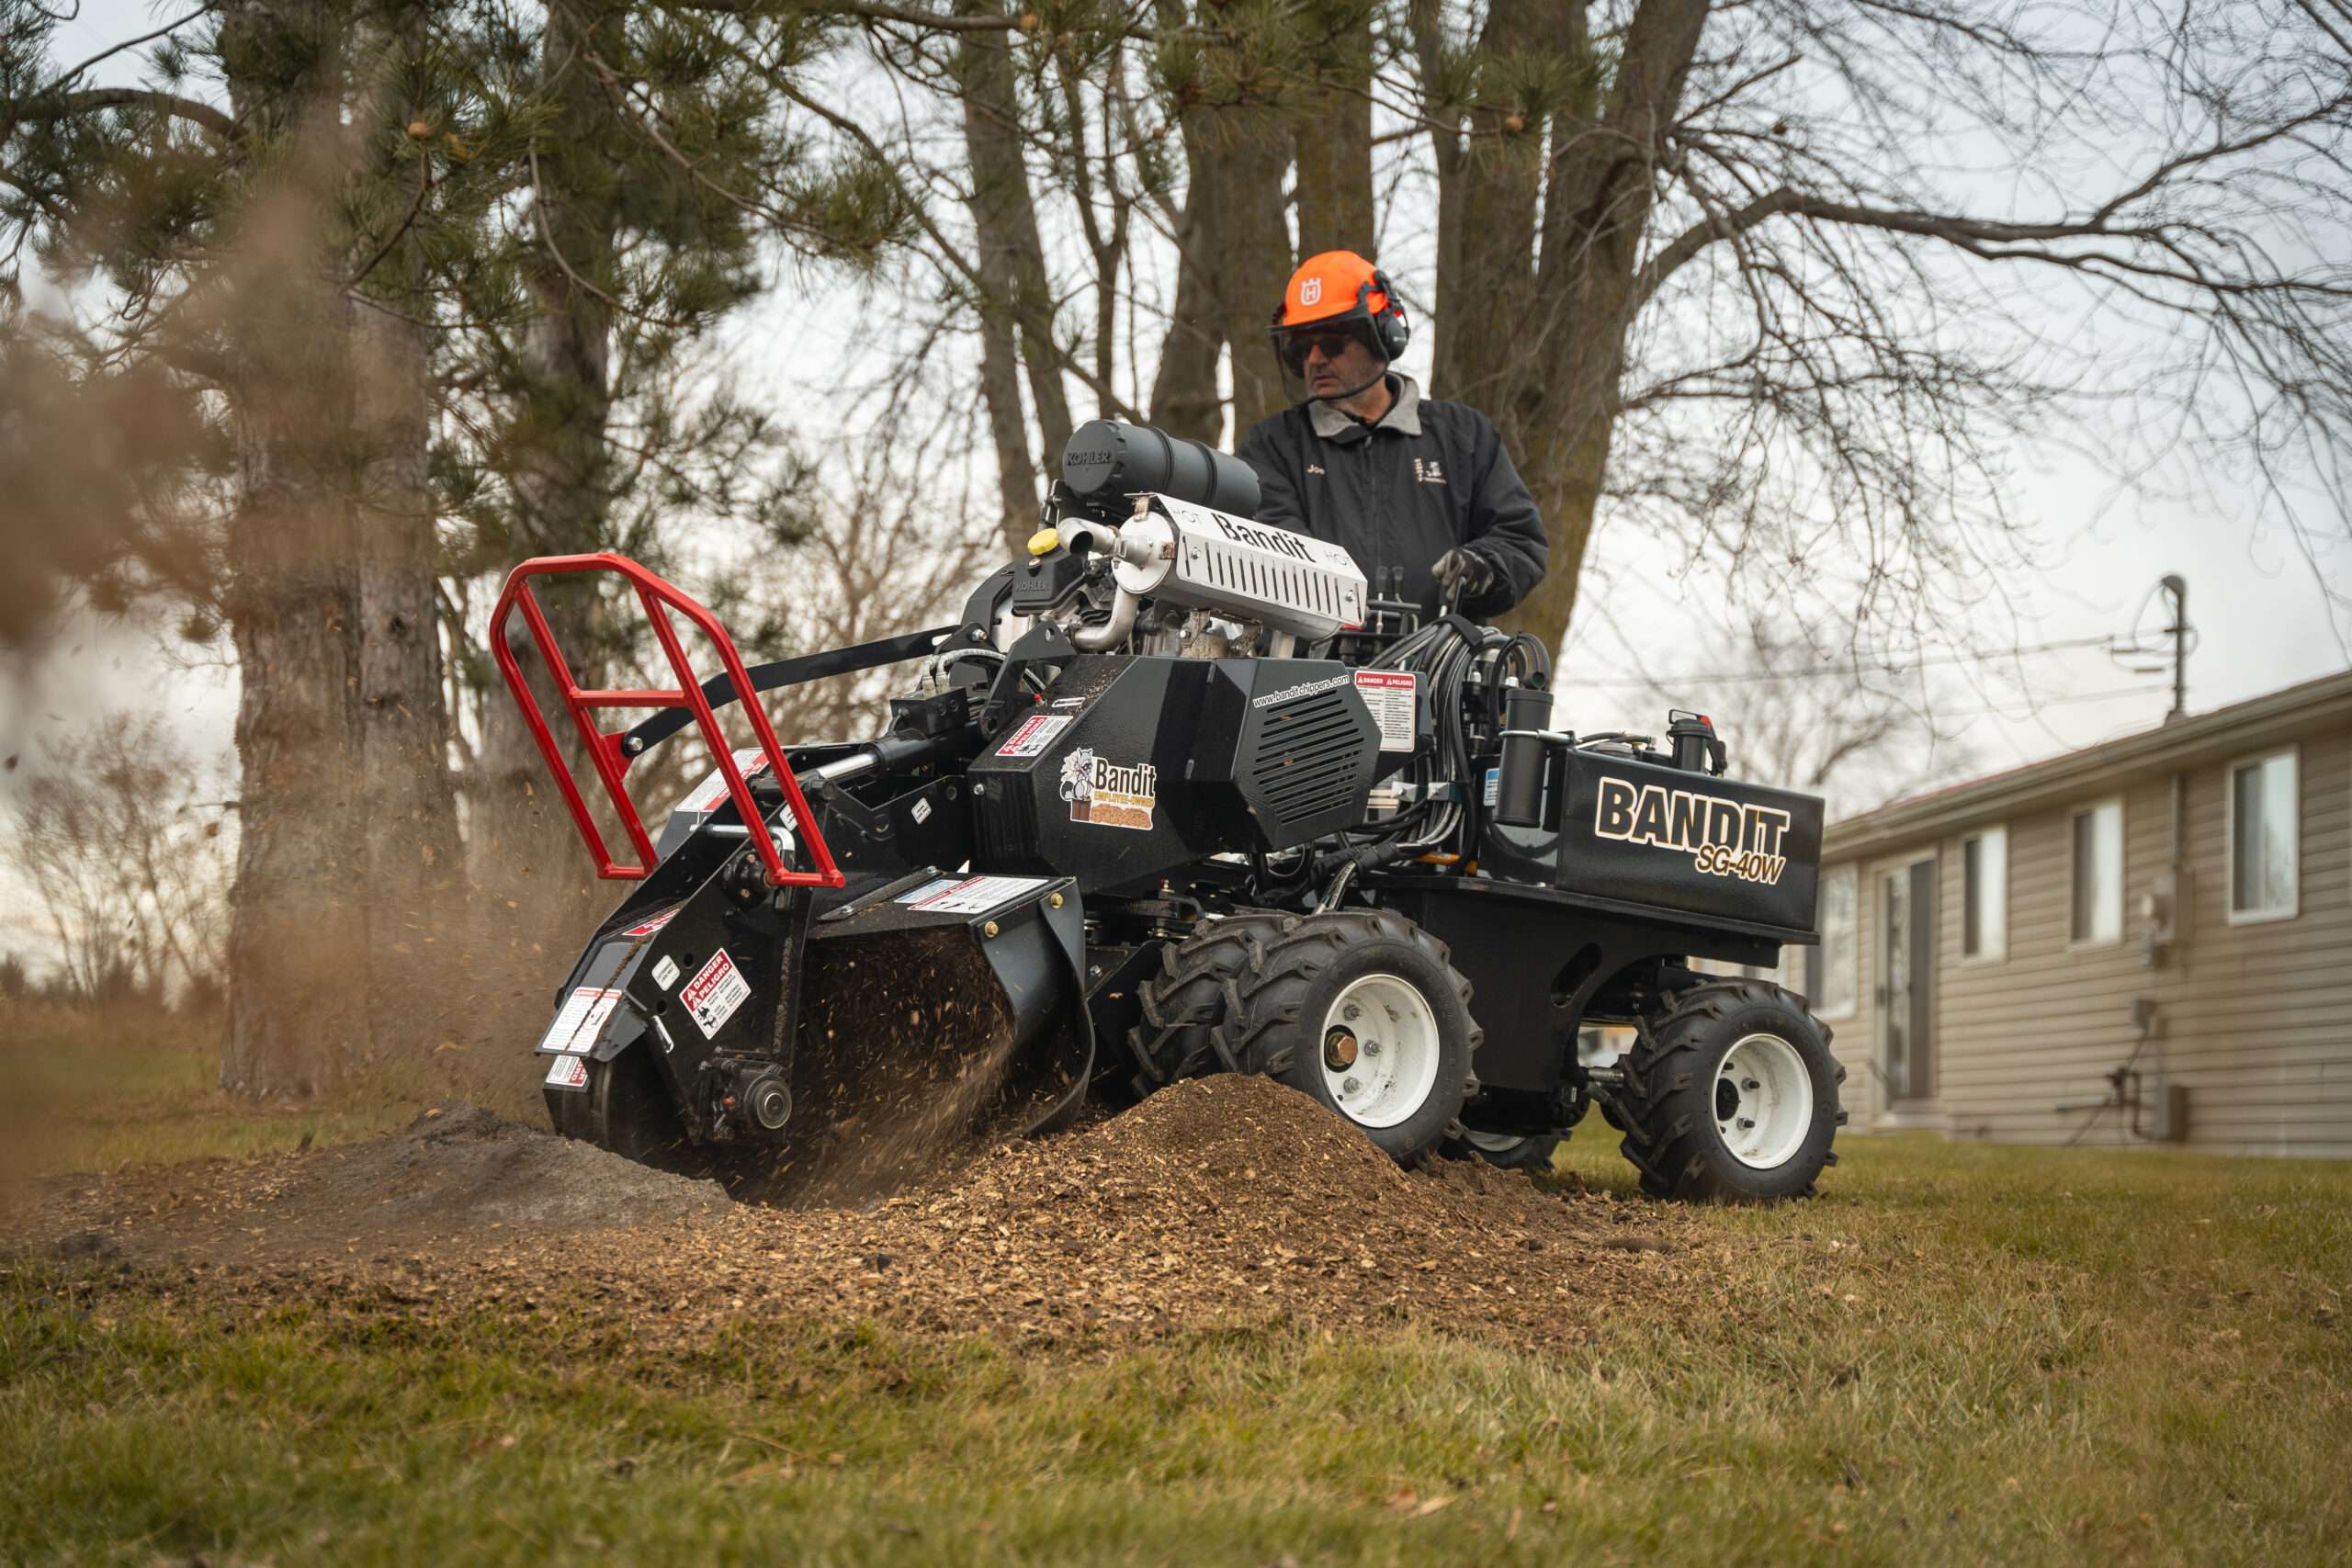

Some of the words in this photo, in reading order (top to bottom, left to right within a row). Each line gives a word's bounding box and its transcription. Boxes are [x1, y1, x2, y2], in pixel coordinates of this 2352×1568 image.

[1067, 451, 1111, 467] KOHLER
[1211, 512, 1317, 563] Bandit
[1252, 674, 1351, 707] www.banditchippers.com
[1094, 758, 1156, 797] Bandit
[1595, 776, 1791, 855] BANDIT
[1695, 843, 1787, 886] SG-40W
[693, 954, 724, 990] DANGER
[698, 962, 730, 999] PELIGRO
